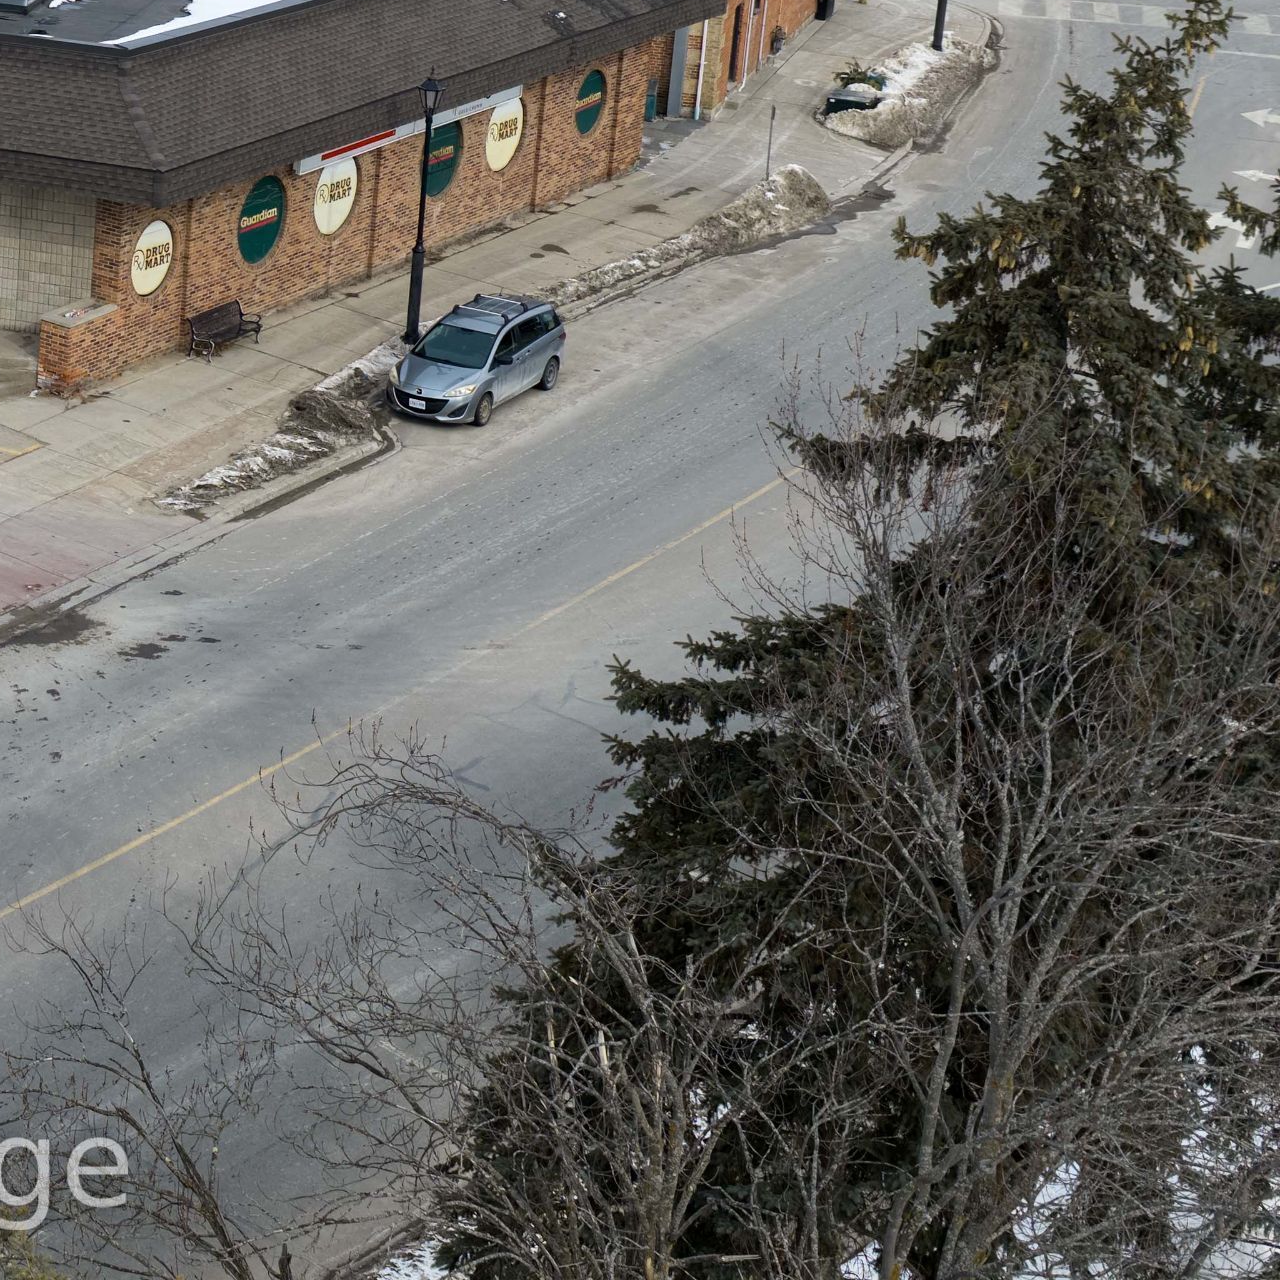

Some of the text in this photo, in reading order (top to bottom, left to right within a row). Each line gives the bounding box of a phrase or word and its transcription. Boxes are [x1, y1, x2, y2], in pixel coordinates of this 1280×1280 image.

[499, 117, 518, 132] DRUG
[498, 126, 518, 142] MART
[330, 177, 352, 193] DRUG
[329, 186, 352, 204] MART
[240, 207, 278, 229] Guardian
[146, 242, 170, 259] DRUG
[145, 253, 171, 270] MART
